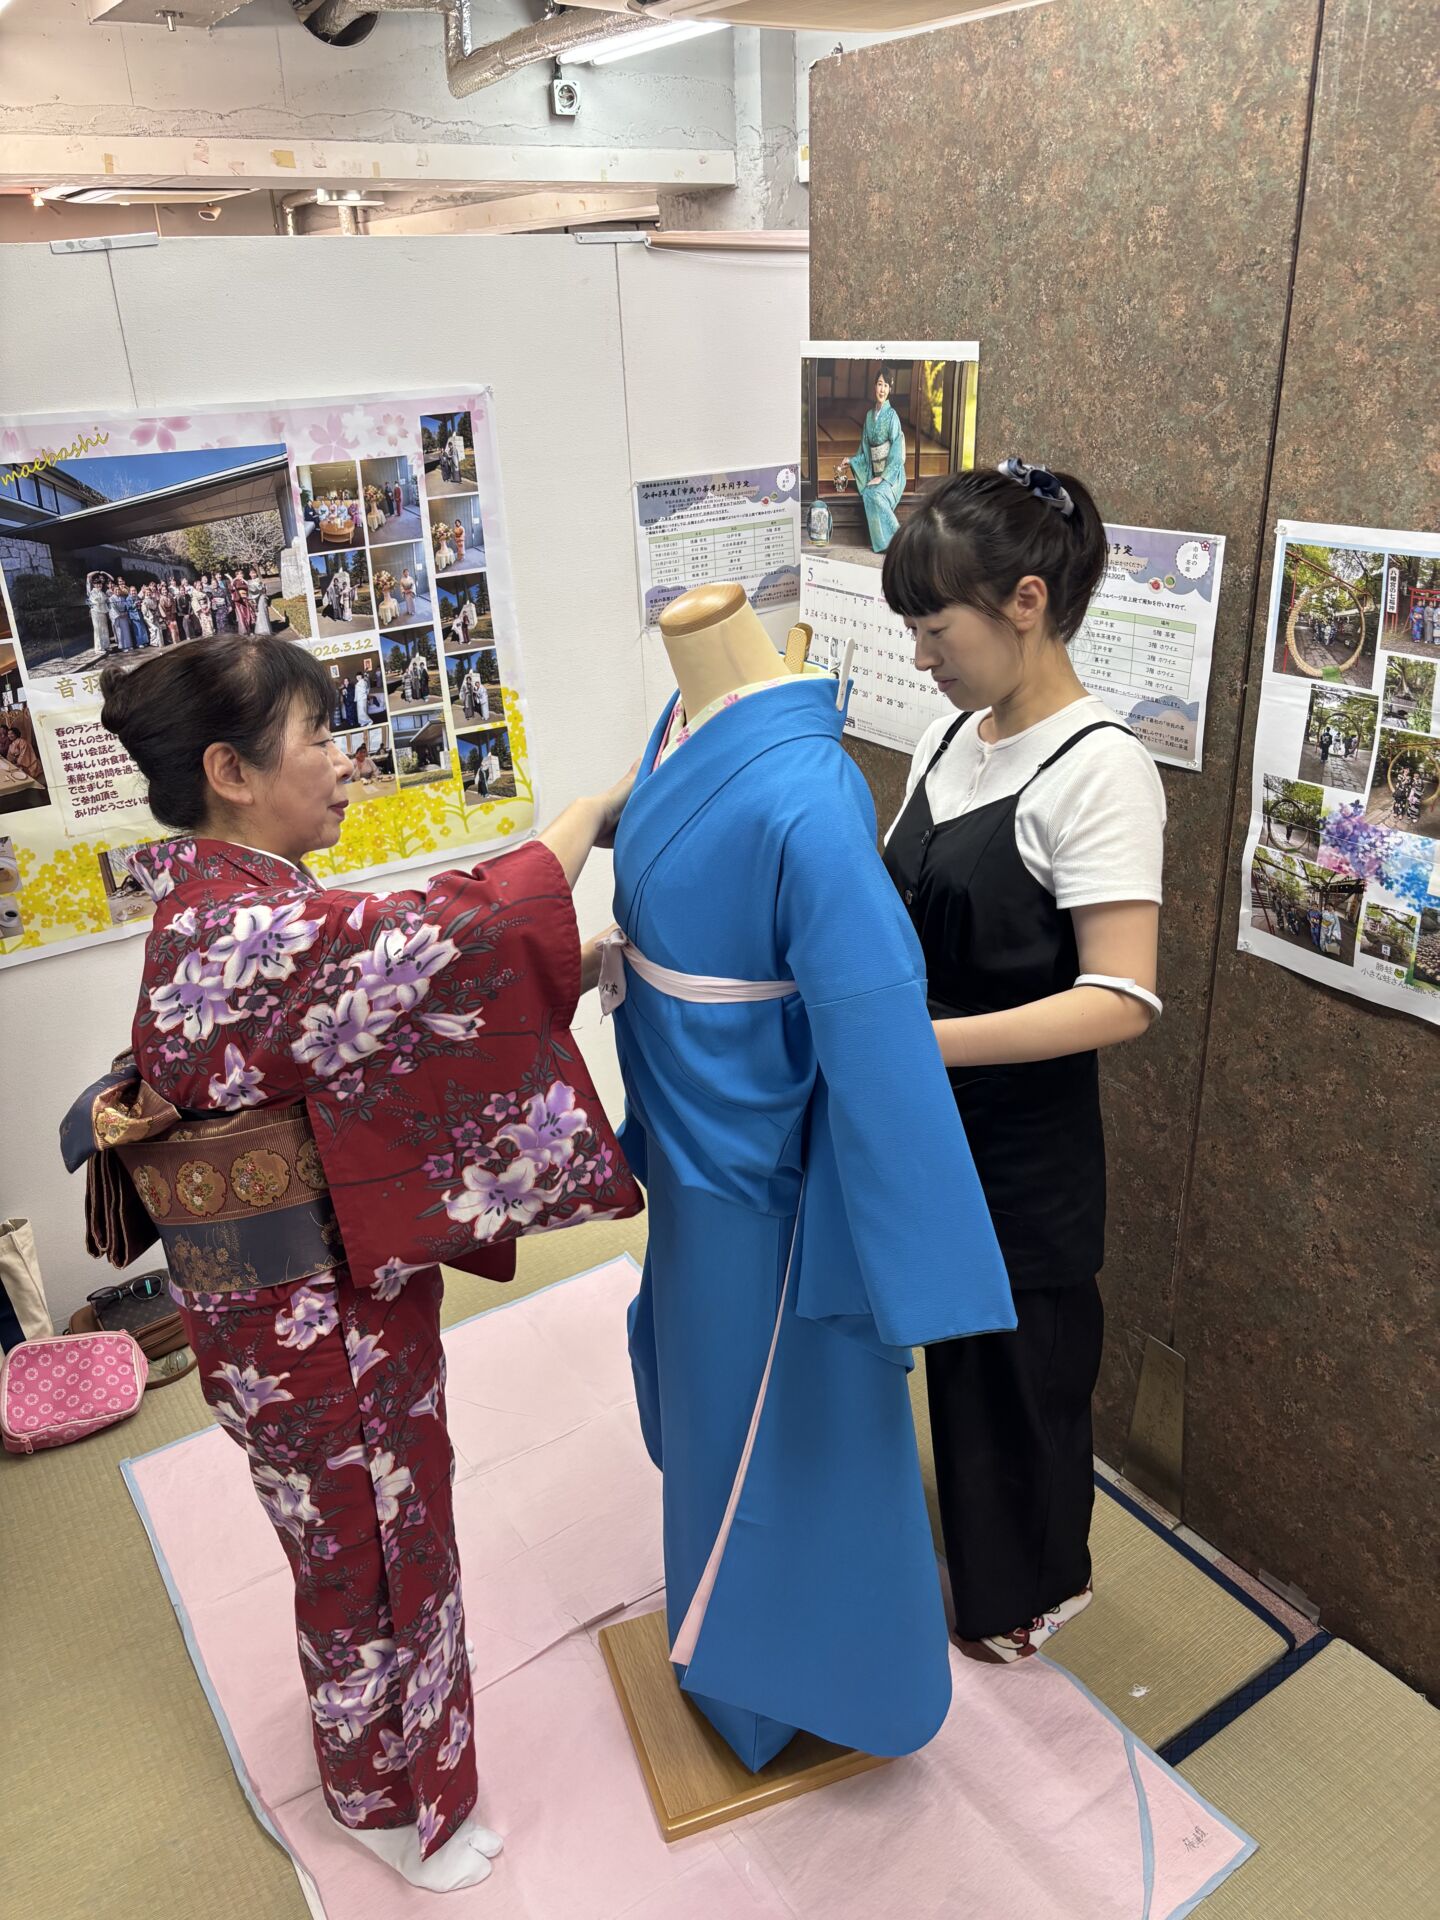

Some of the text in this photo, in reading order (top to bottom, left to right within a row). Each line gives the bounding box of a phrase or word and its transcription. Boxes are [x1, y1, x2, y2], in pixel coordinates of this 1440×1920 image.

[1, 426, 109, 486] maebashi
[1107, 543, 1133, 556] 予定
[807, 567, 814, 582] 5
[311, 638, 373, 656] 026.3.12
[55, 722, 105, 737] 春のランチ
[60, 744, 116, 760] 楽しい会話と
[68, 780, 113, 794] できました
[72, 790, 119, 806] ご参加頂き
